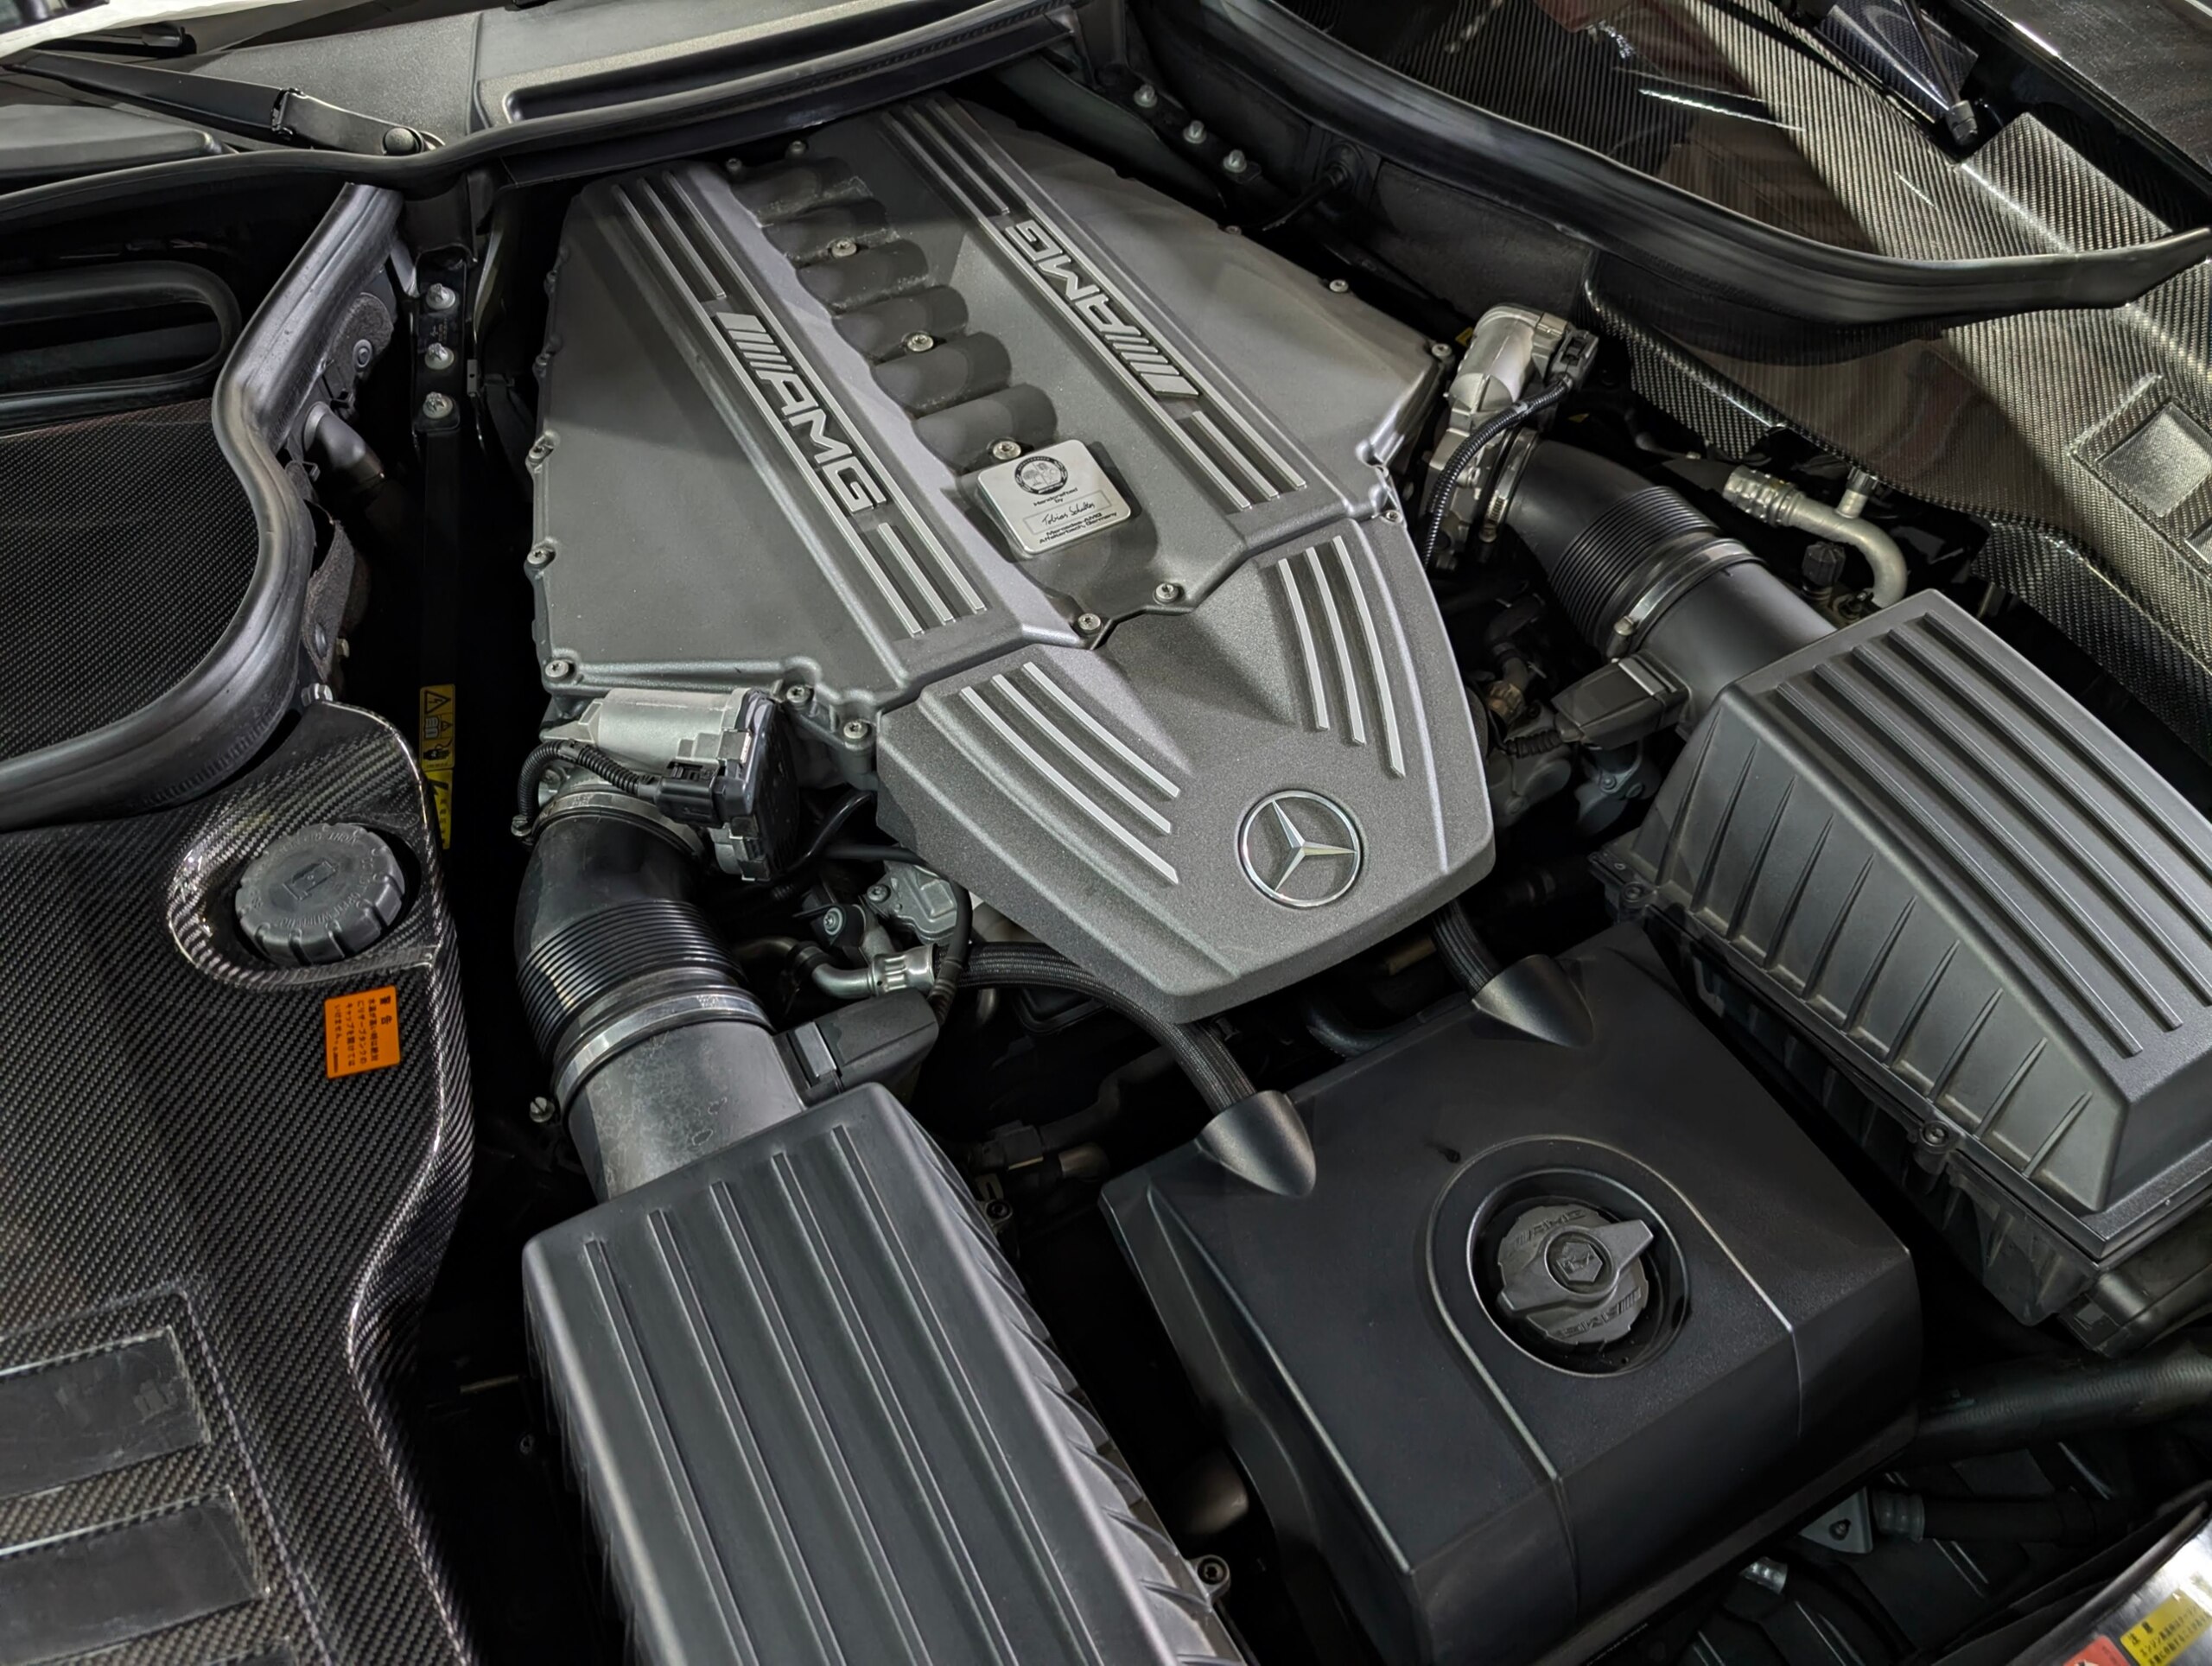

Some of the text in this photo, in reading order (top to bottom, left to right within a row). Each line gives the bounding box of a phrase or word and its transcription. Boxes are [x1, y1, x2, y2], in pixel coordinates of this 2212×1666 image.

[1005, 219, 1141, 336] AMG
[755, 369, 887, 513] AMG
[1046, 512, 1103, 537] Mercedes-AMG
